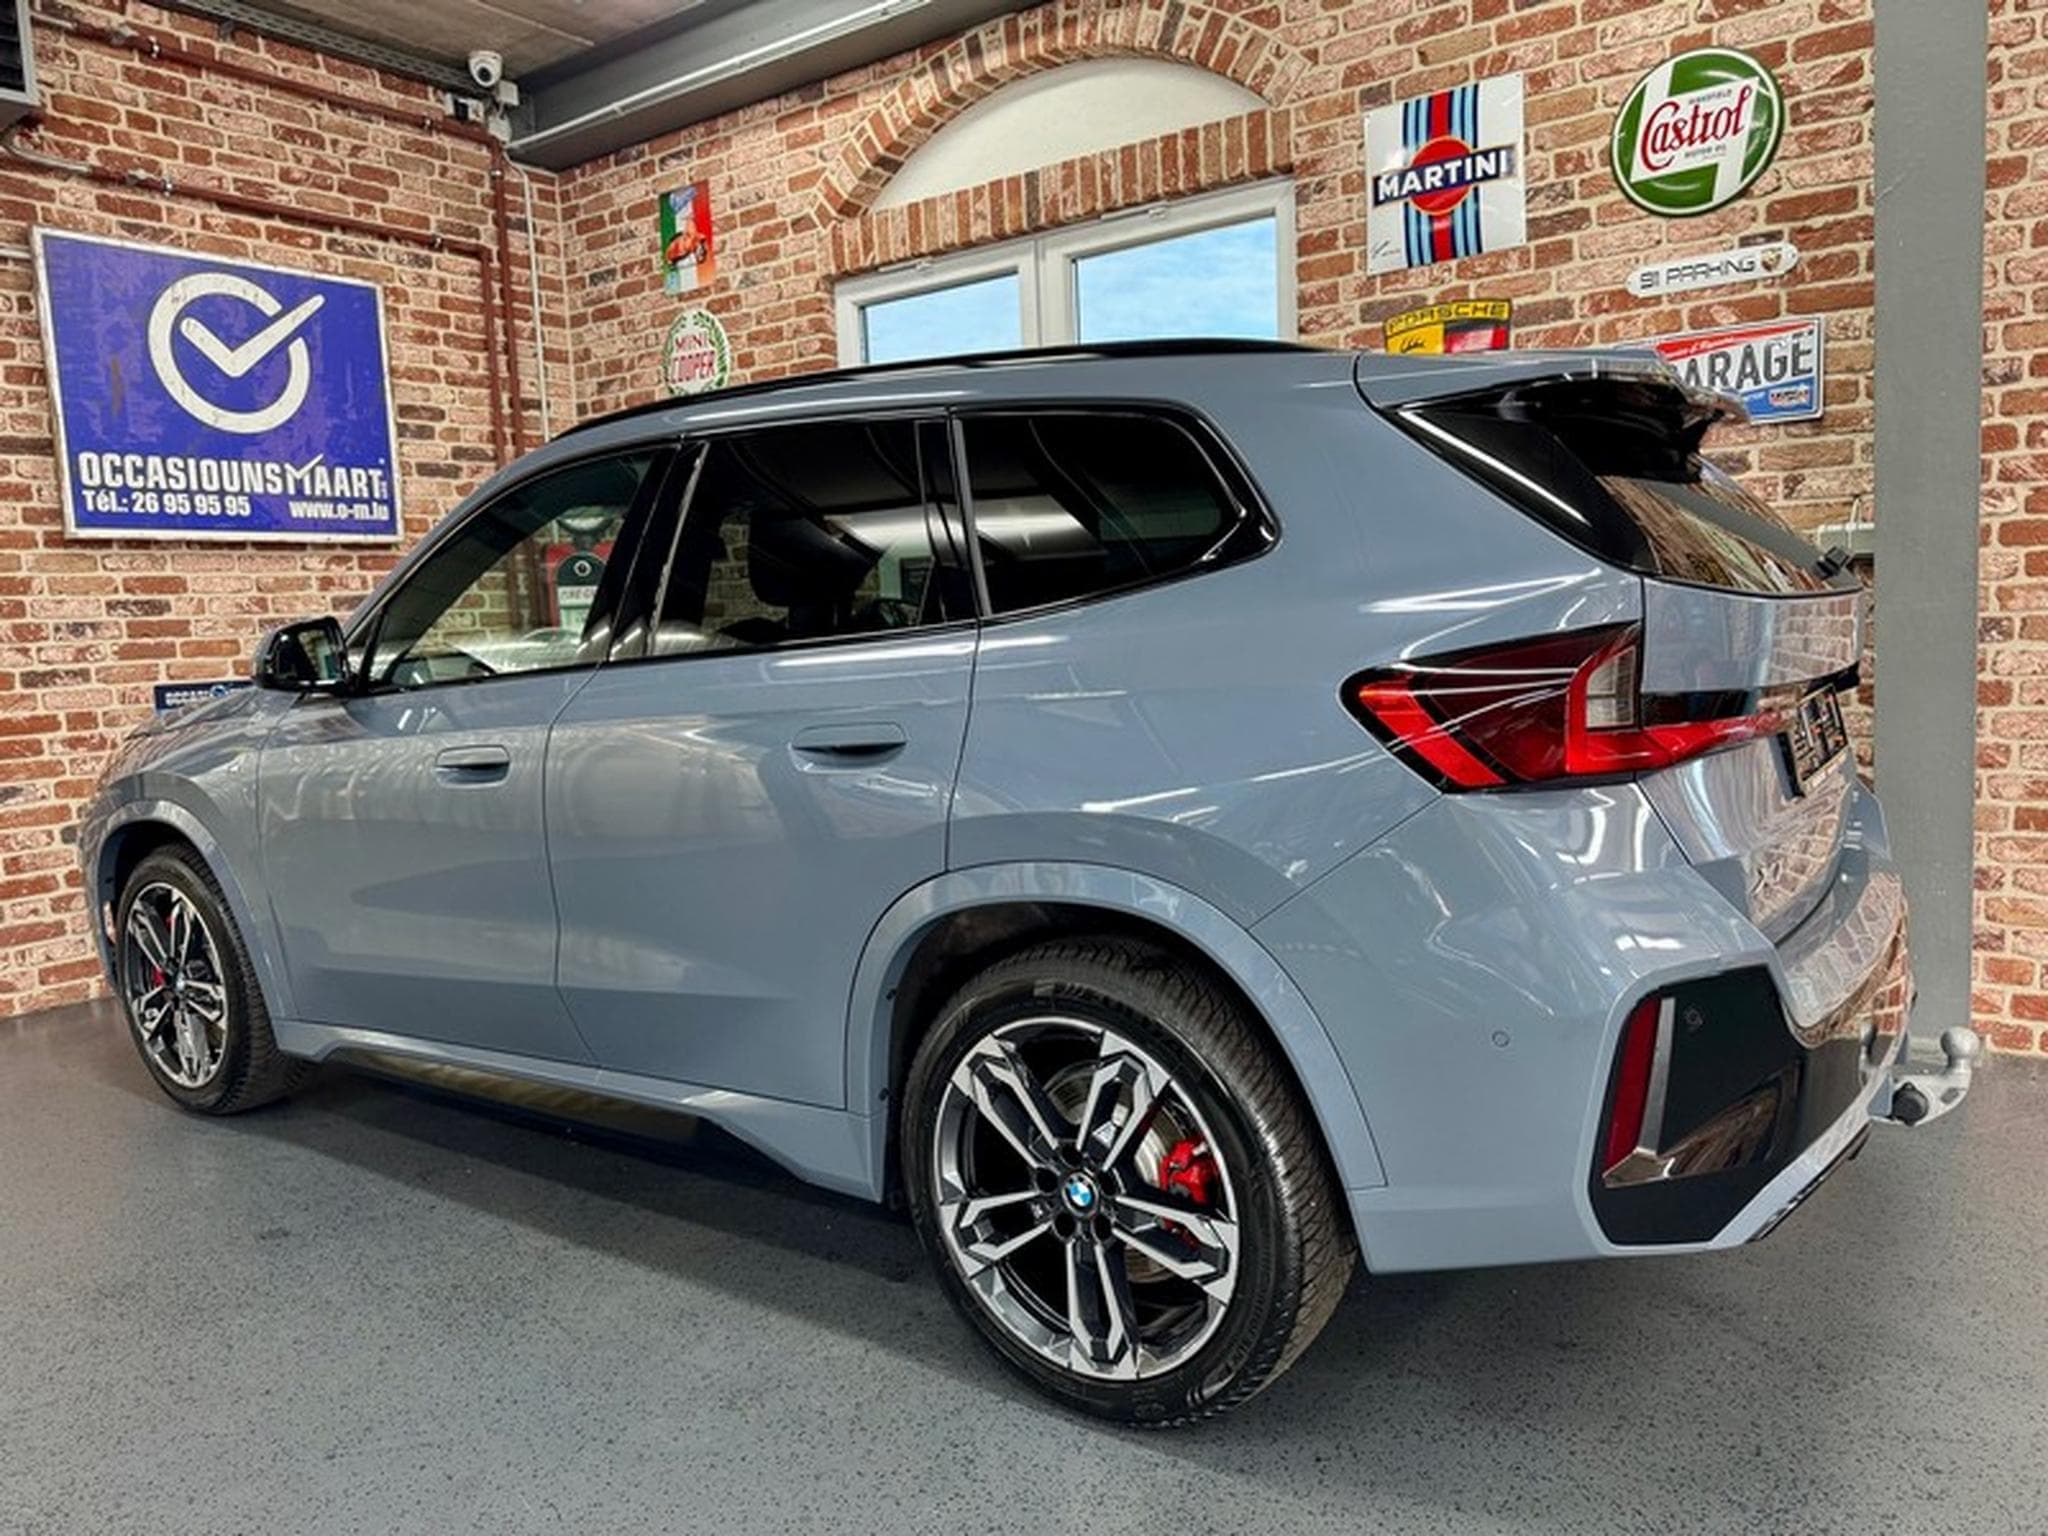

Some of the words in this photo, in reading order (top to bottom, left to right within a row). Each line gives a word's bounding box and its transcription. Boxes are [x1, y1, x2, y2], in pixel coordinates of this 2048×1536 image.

[1641, 84, 1752, 171] Castrol
[1378, 150, 1507, 201] MARTINI
[1666, 256, 1756, 285] PARKING
[1387, 301, 1506, 333] PORSCHE
[675, 331, 708, 352] MINI
[671, 351, 715, 384] COOPER
[1668, 329, 1814, 390] ARAGE
[78, 452, 383, 499] OCCASIOUNSMAART
[131, 491, 160, 514] 26
[163, 492, 192, 516] 95
[195, 494, 222, 517] 95
[225, 495, 252, 517] 95
[288, 500, 390, 521] www.o-m.lu
